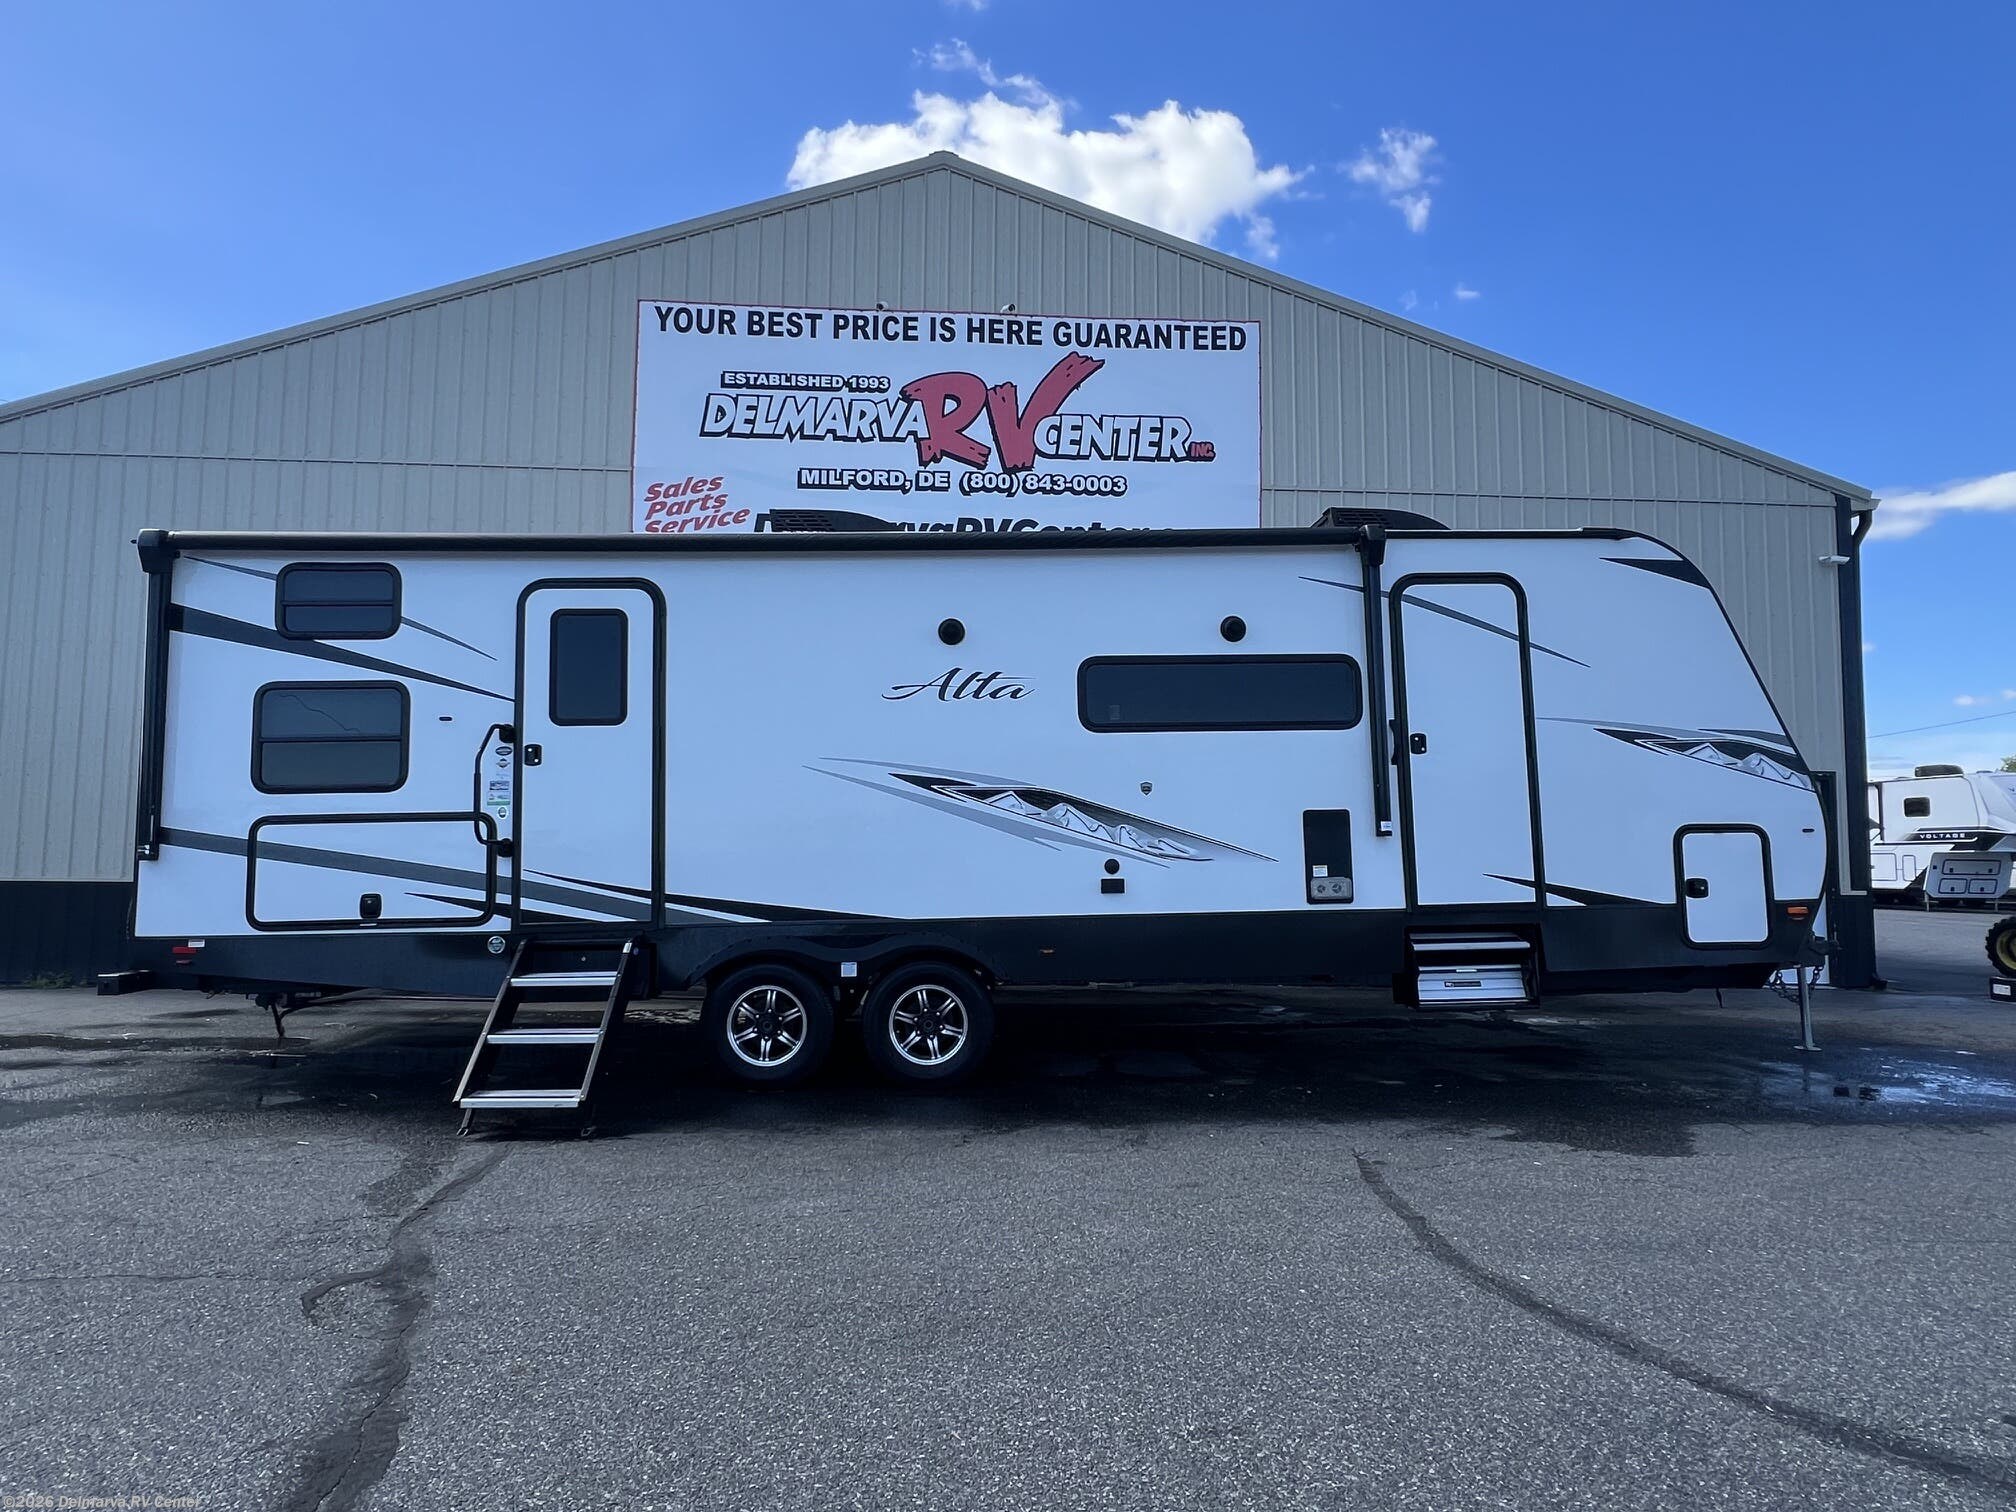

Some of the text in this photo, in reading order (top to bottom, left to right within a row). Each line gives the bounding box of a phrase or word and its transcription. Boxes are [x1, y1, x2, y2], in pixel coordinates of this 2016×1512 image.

[655, 306, 1247, 351] YOUR BEST PRICE IS HERE GUARANTEED
[722, 372, 890, 393] ESTABLISHED 1993
[701, 393, 931, 442] DELMARVA
[900, 350, 1105, 474] RV
[1032, 414, 1191, 462] CENTER
[644, 476, 724, 502] Sales
[798, 468, 1127, 497] MILFORD, DE (800) 843-0003
[645, 494, 728, 520] Parts
[881, 667, 1037, 701] Alta
